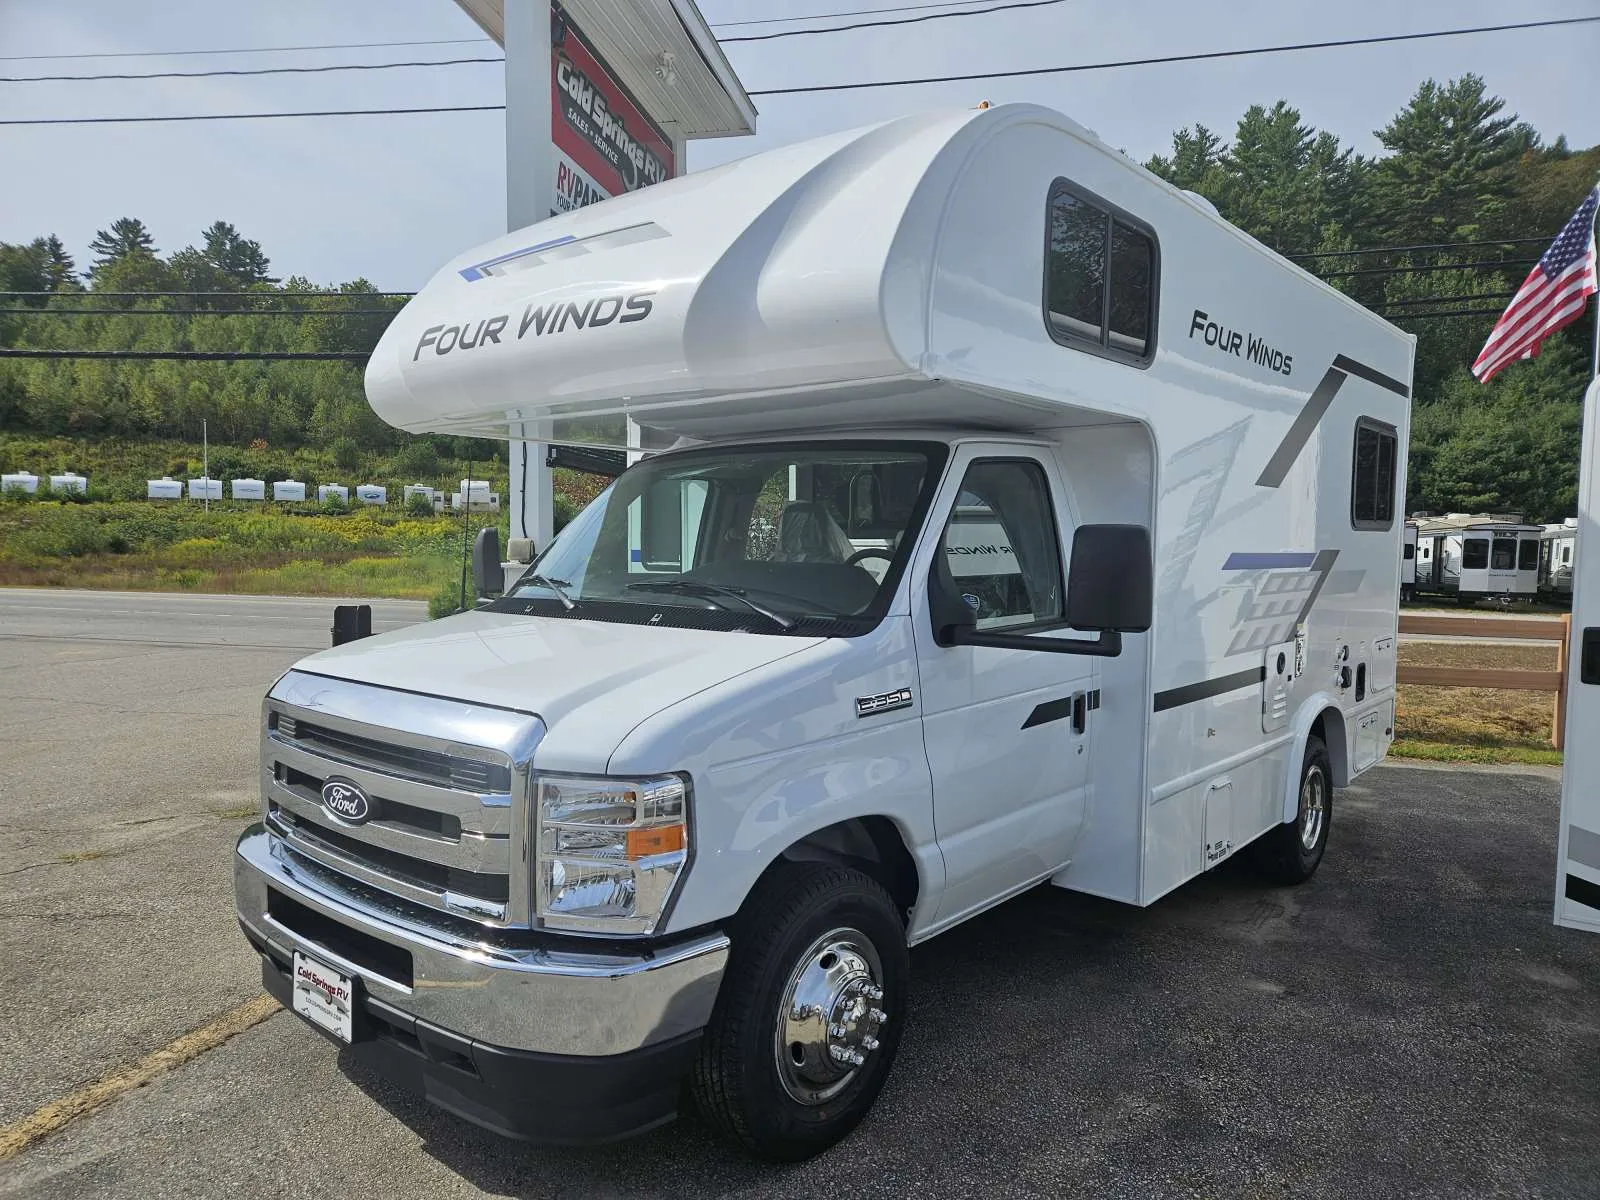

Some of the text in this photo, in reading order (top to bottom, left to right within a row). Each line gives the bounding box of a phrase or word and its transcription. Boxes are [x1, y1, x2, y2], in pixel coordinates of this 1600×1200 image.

[557, 59, 593, 115] Cold
[592, 95, 644, 188] Springs
[567, 107, 618, 165] SALES SERVICE
[413, 291, 656, 361] FOUR WINDS
[1189, 309, 1293, 376] FOUR WINDS
[330, 786, 358, 815] Ford
[297, 966, 349, 1004] Cold Springs RV
